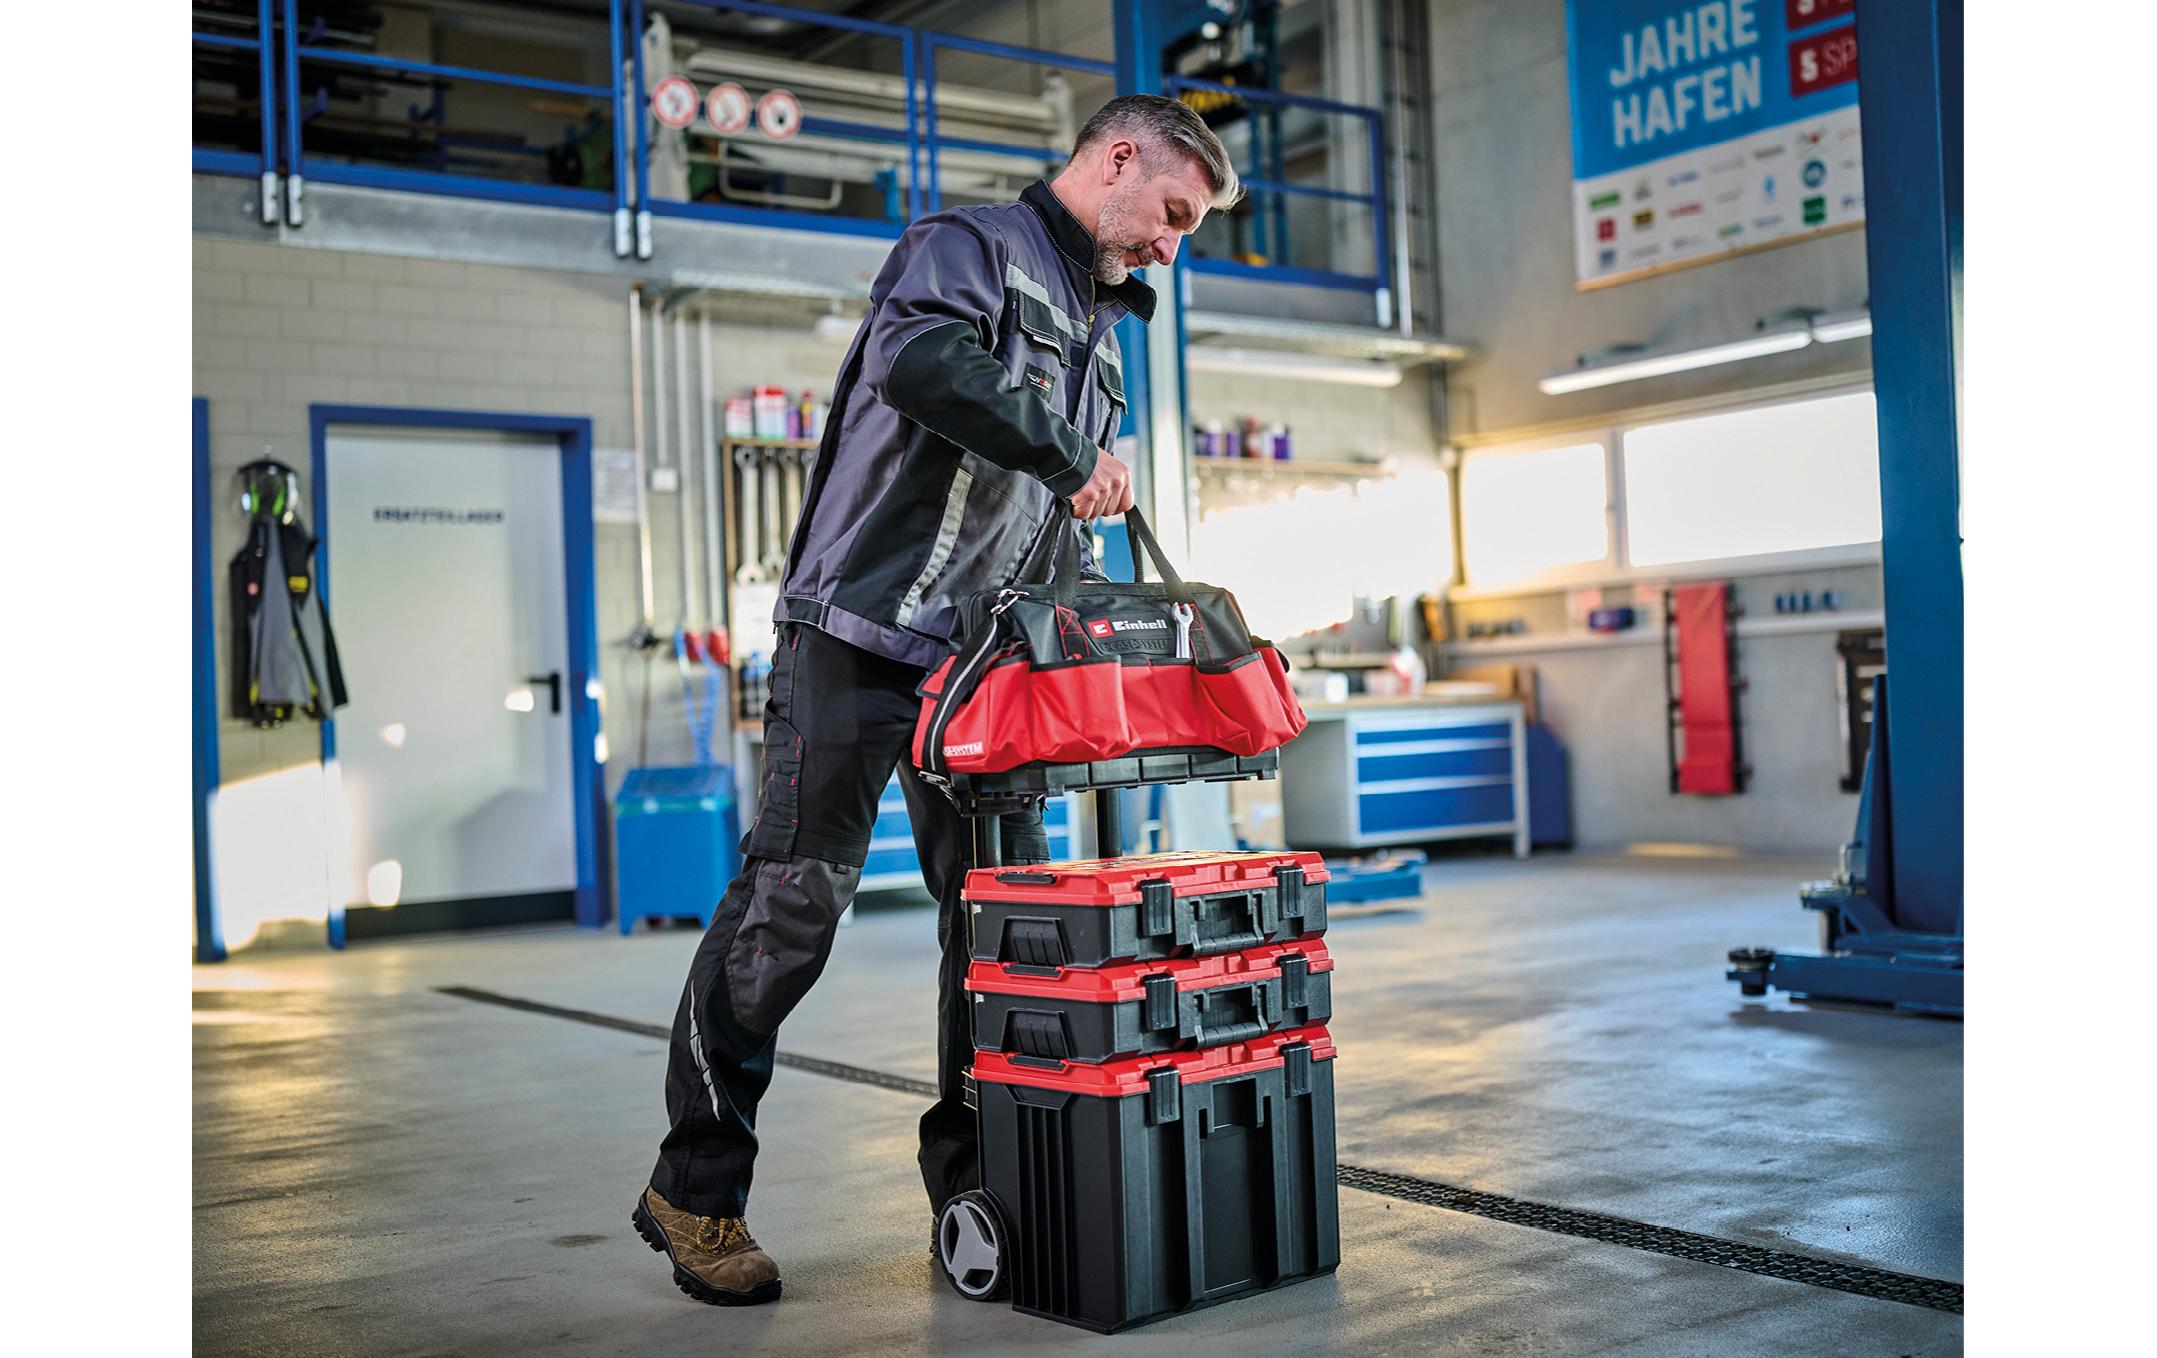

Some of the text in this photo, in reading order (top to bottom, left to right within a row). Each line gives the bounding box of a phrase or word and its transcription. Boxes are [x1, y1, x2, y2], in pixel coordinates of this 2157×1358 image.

[1609, 0, 1760, 88] JAHRE
[1613, 55, 1761, 148] HAFEN
[1112, 619, 1168, 631] Einhell
